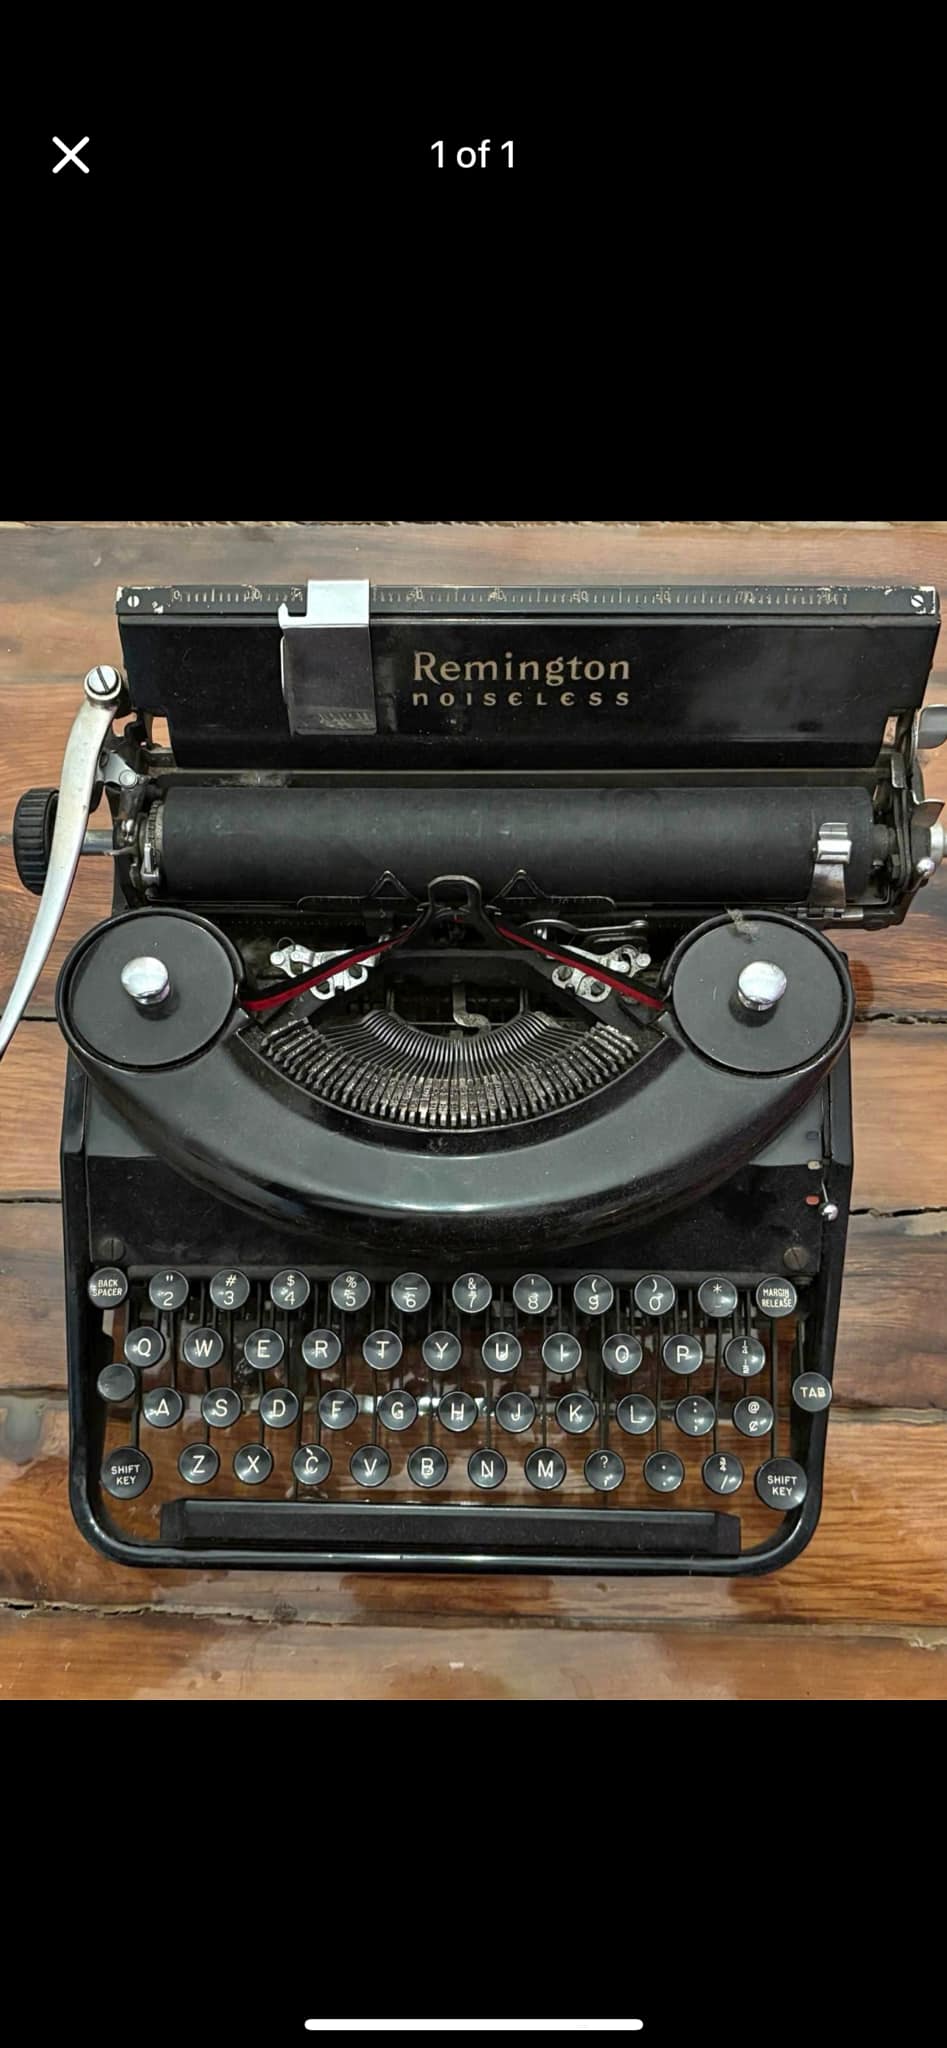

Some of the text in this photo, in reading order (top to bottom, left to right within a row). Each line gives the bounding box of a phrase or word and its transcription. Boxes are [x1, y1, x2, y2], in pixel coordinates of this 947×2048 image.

[413, 651, 630, 686] Remington
[98, 1279, 119, 1288] BACK
[225, 1275, 237, 1286] #
[286, 1275, 295, 1287] $
[345, 1276, 357, 1288] %
[468, 1278, 477, 1290] &
[91, 1287, 123, 1297] SPACER
[163, 1292, 174, 1306] 2
[223, 1291, 234, 1305] 3
[284, 1291, 296, 1305] 4
[345, 1292, 356, 1306] 5
[468, 1292, 478, 1308] 7
[763, 1288, 790, 1299] MARGIN
[406, 1293, 417, 1308] 6
[527, 1294, 538, 1310] 8
[589, 1295, 599, 1310] 9
[762, 1298, 792, 1308] RELEASE
[137, 1338, 152, 1357] Q
[195, 1339, 213, 1357] W
[257, 1340, 270, 1358] E
[315, 1340, 328, 1358] R
[376, 1340, 390, 1359] T
[435, 1342, 449, 1360] Y
[495, 1343, 509, 1361] U
[676, 1345, 690, 1363] P
[800, 1386, 826, 1398] TAB
[156, 1399, 170, 1416] A
[215, 1399, 228, 1417] S
[272, 1400, 286, 1417] D
[332, 1401, 344, 1417] F
[391, 1401, 404, 1419] G
[450, 1403, 464, 1421] H
[510, 1404, 521, 1421] J
[569, 1404, 583, 1422] K
[630, 1405, 645, 1423] L
[748, 1401, 760, 1414] @
[111, 1464, 140, 1475] SHIFT
[192, 1455, 205, 1473] Z
[247, 1456, 260, 1474] X
[363, 1458, 378, 1476] V
[421, 1458, 434, 1476] B
[481, 1460, 494, 1477] N
[538, 1460, 553, 1478] M
[600, 1456, 608, 1468] ?
[116, 1476, 137, 1486] KEY
[767, 1475, 798, 1486] SHIFT
[772, 1486, 793, 1497] KEY
